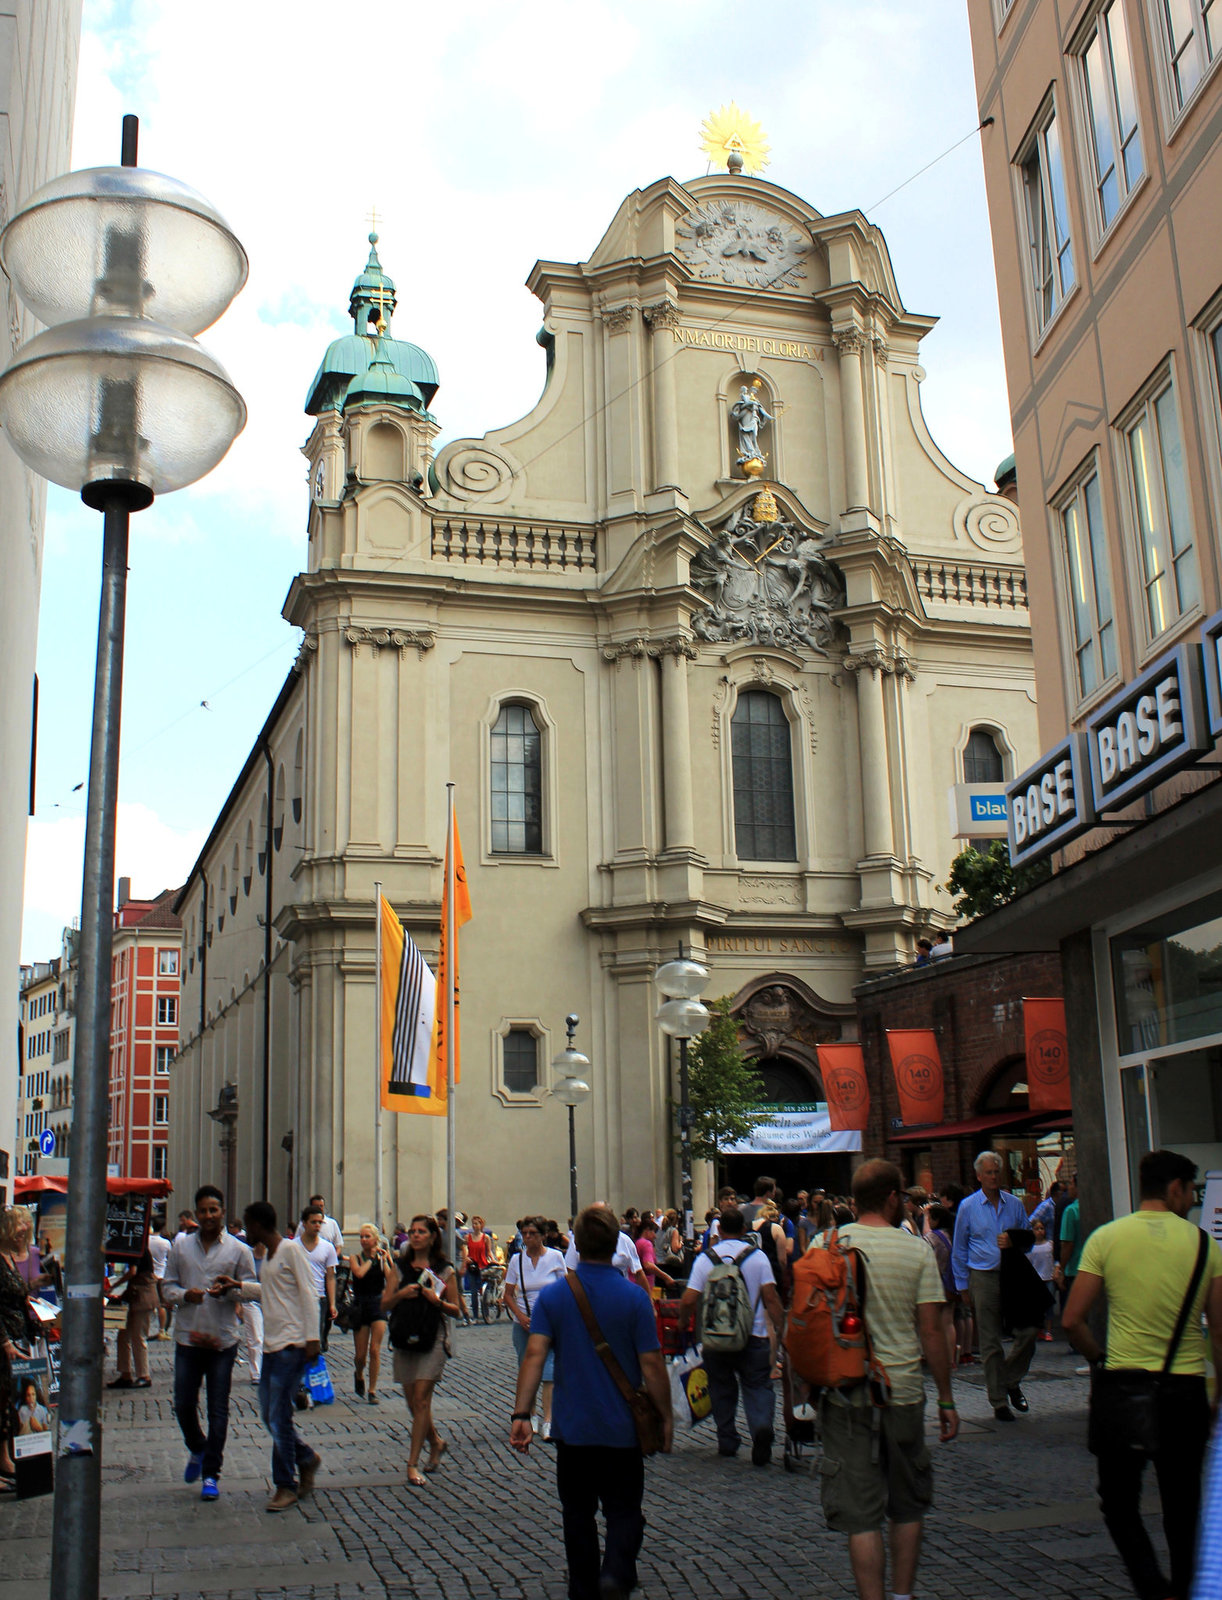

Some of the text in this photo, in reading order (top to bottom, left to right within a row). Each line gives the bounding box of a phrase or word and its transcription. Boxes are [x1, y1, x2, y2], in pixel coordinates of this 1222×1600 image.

[736, 336, 761, 353] DEI
[1097, 676, 1183, 785] BASE
[1012, 759, 1075, 846] BASE
[707, 936, 773, 952] PIRITUI
[1039, 1046, 1061, 1058] 140
[909, 1068, 931, 1079] 140
[836, 1080, 856, 1090] 140
[785, 1129, 801, 1139] des
